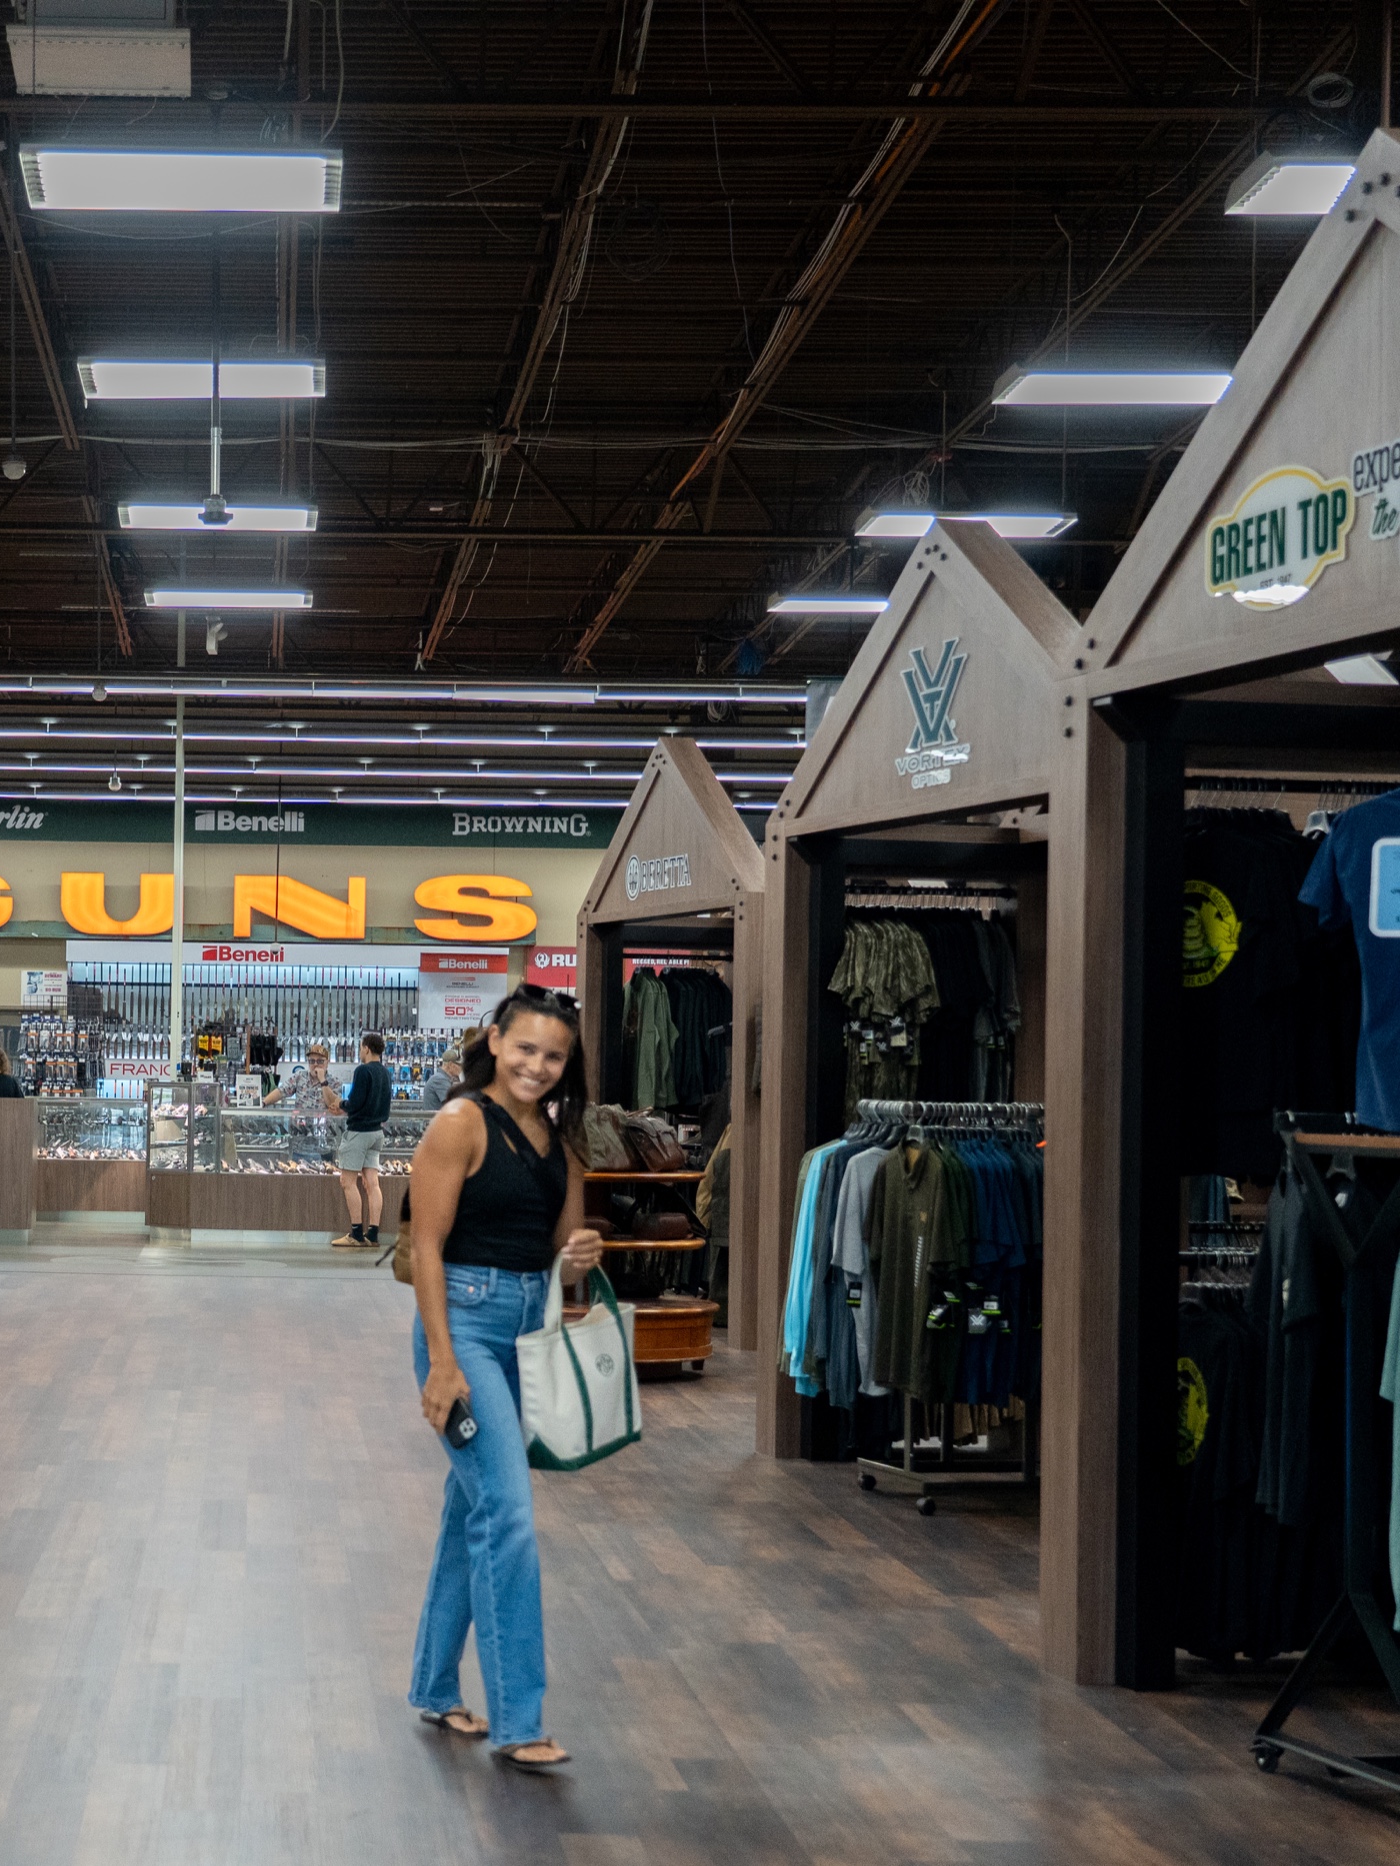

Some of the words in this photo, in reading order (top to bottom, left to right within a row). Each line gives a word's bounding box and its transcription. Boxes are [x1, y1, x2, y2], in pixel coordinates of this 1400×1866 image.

[1371, 497, 1398, 536] the
[1211, 506, 1286, 586] GREEN
[1297, 488, 1347, 560] TOP
[217, 809, 305, 833] Benelli
[452, 812, 589, 837] BROWNING
[639, 853, 692, 893] BERETTA
[218, 945, 284, 962] Benelli
[448, 958, 488, 970] Benelli
[551, 953, 577, 968] RU
[444, 1006, 474, 1016] 50%
